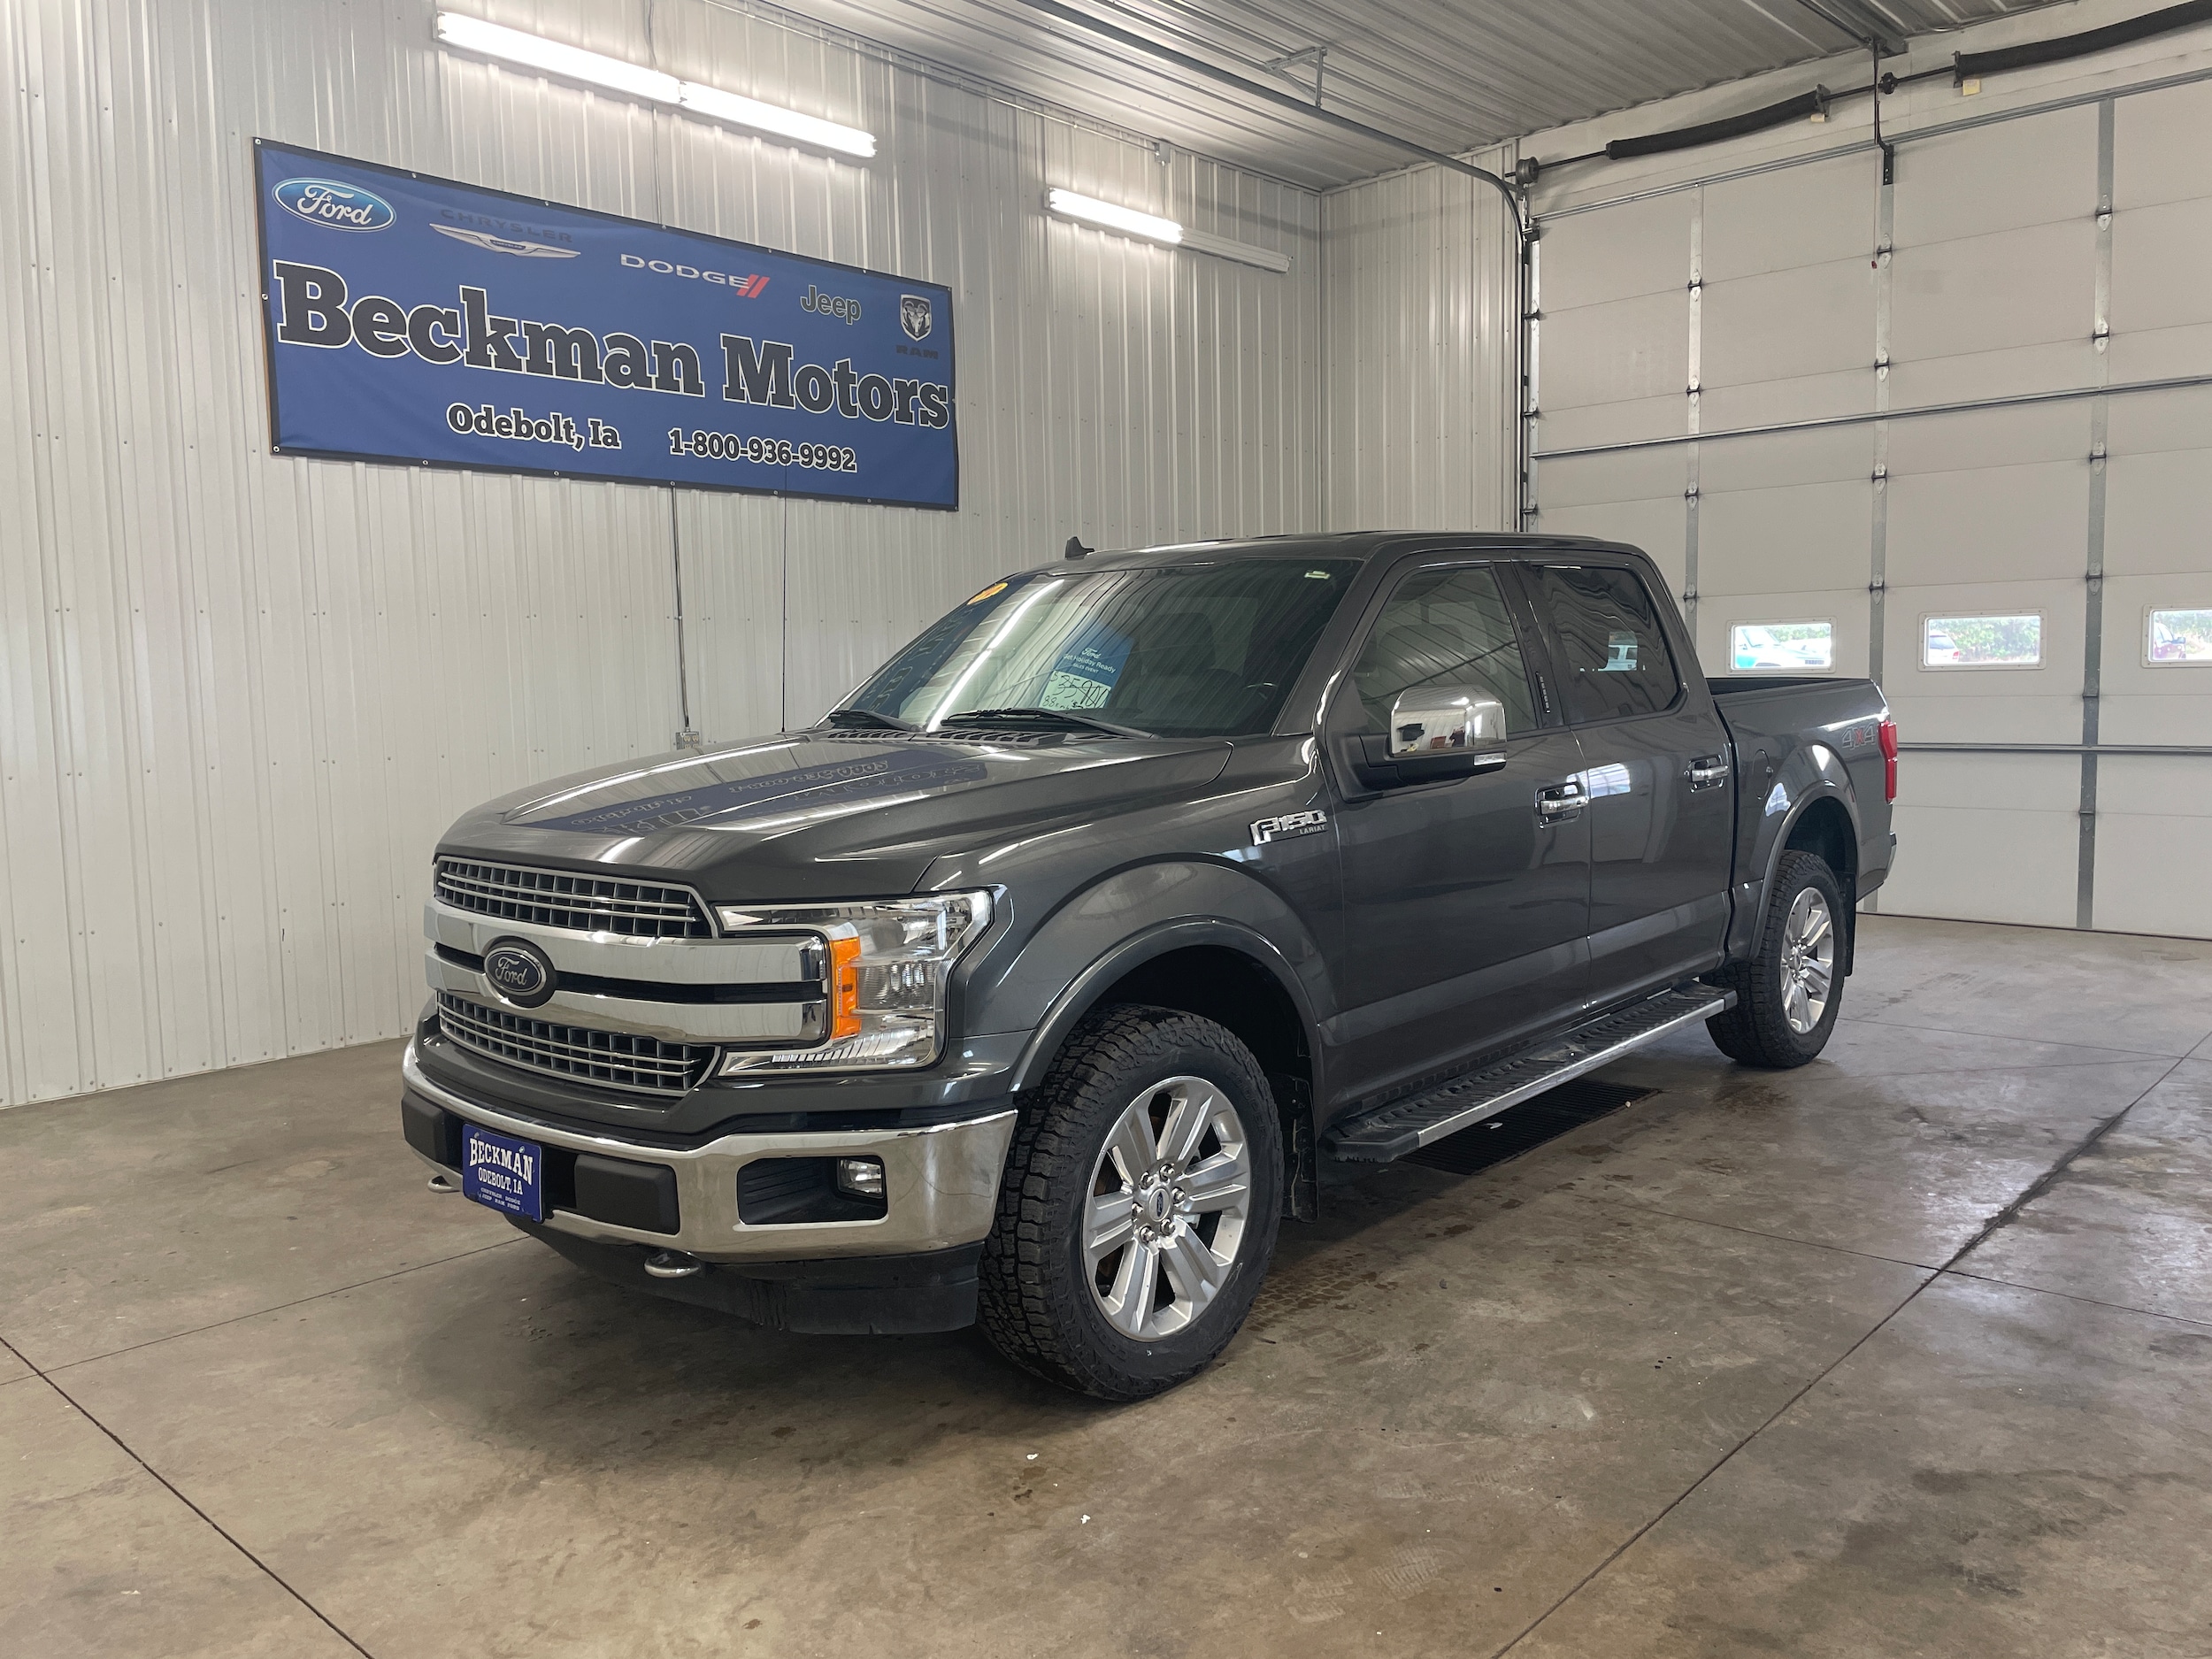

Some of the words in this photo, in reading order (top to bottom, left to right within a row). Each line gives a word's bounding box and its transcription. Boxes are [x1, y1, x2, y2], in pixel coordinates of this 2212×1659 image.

[296, 185, 373, 227] Ford
[441, 209, 572, 243] CHRYSLER
[620, 253, 750, 289] DODGE
[800, 285, 862, 325] Jeep
[273, 259, 705, 397] Beckman
[719, 333, 949, 429] Motors
[896, 344, 939, 360] RAM
[446, 403, 584, 452] Odebolt,
[588, 418, 622, 449] Ia
[668, 427, 857, 472] 1-800-936-9992
[1073, 655, 1097, 667] Holiday
[1095, 662, 1117, 674] Ready
[1081, 647, 1102, 659] Ford
[1299, 824, 1326, 835] LARIAT
[495, 956, 528, 986] Ford
[469, 1138, 534, 1186] BECKMAN
[478, 1167, 512, 1194] ODEBOLT,
[512, 1178, 524, 1195] IA
[494, 1198, 505, 1207] RAM
